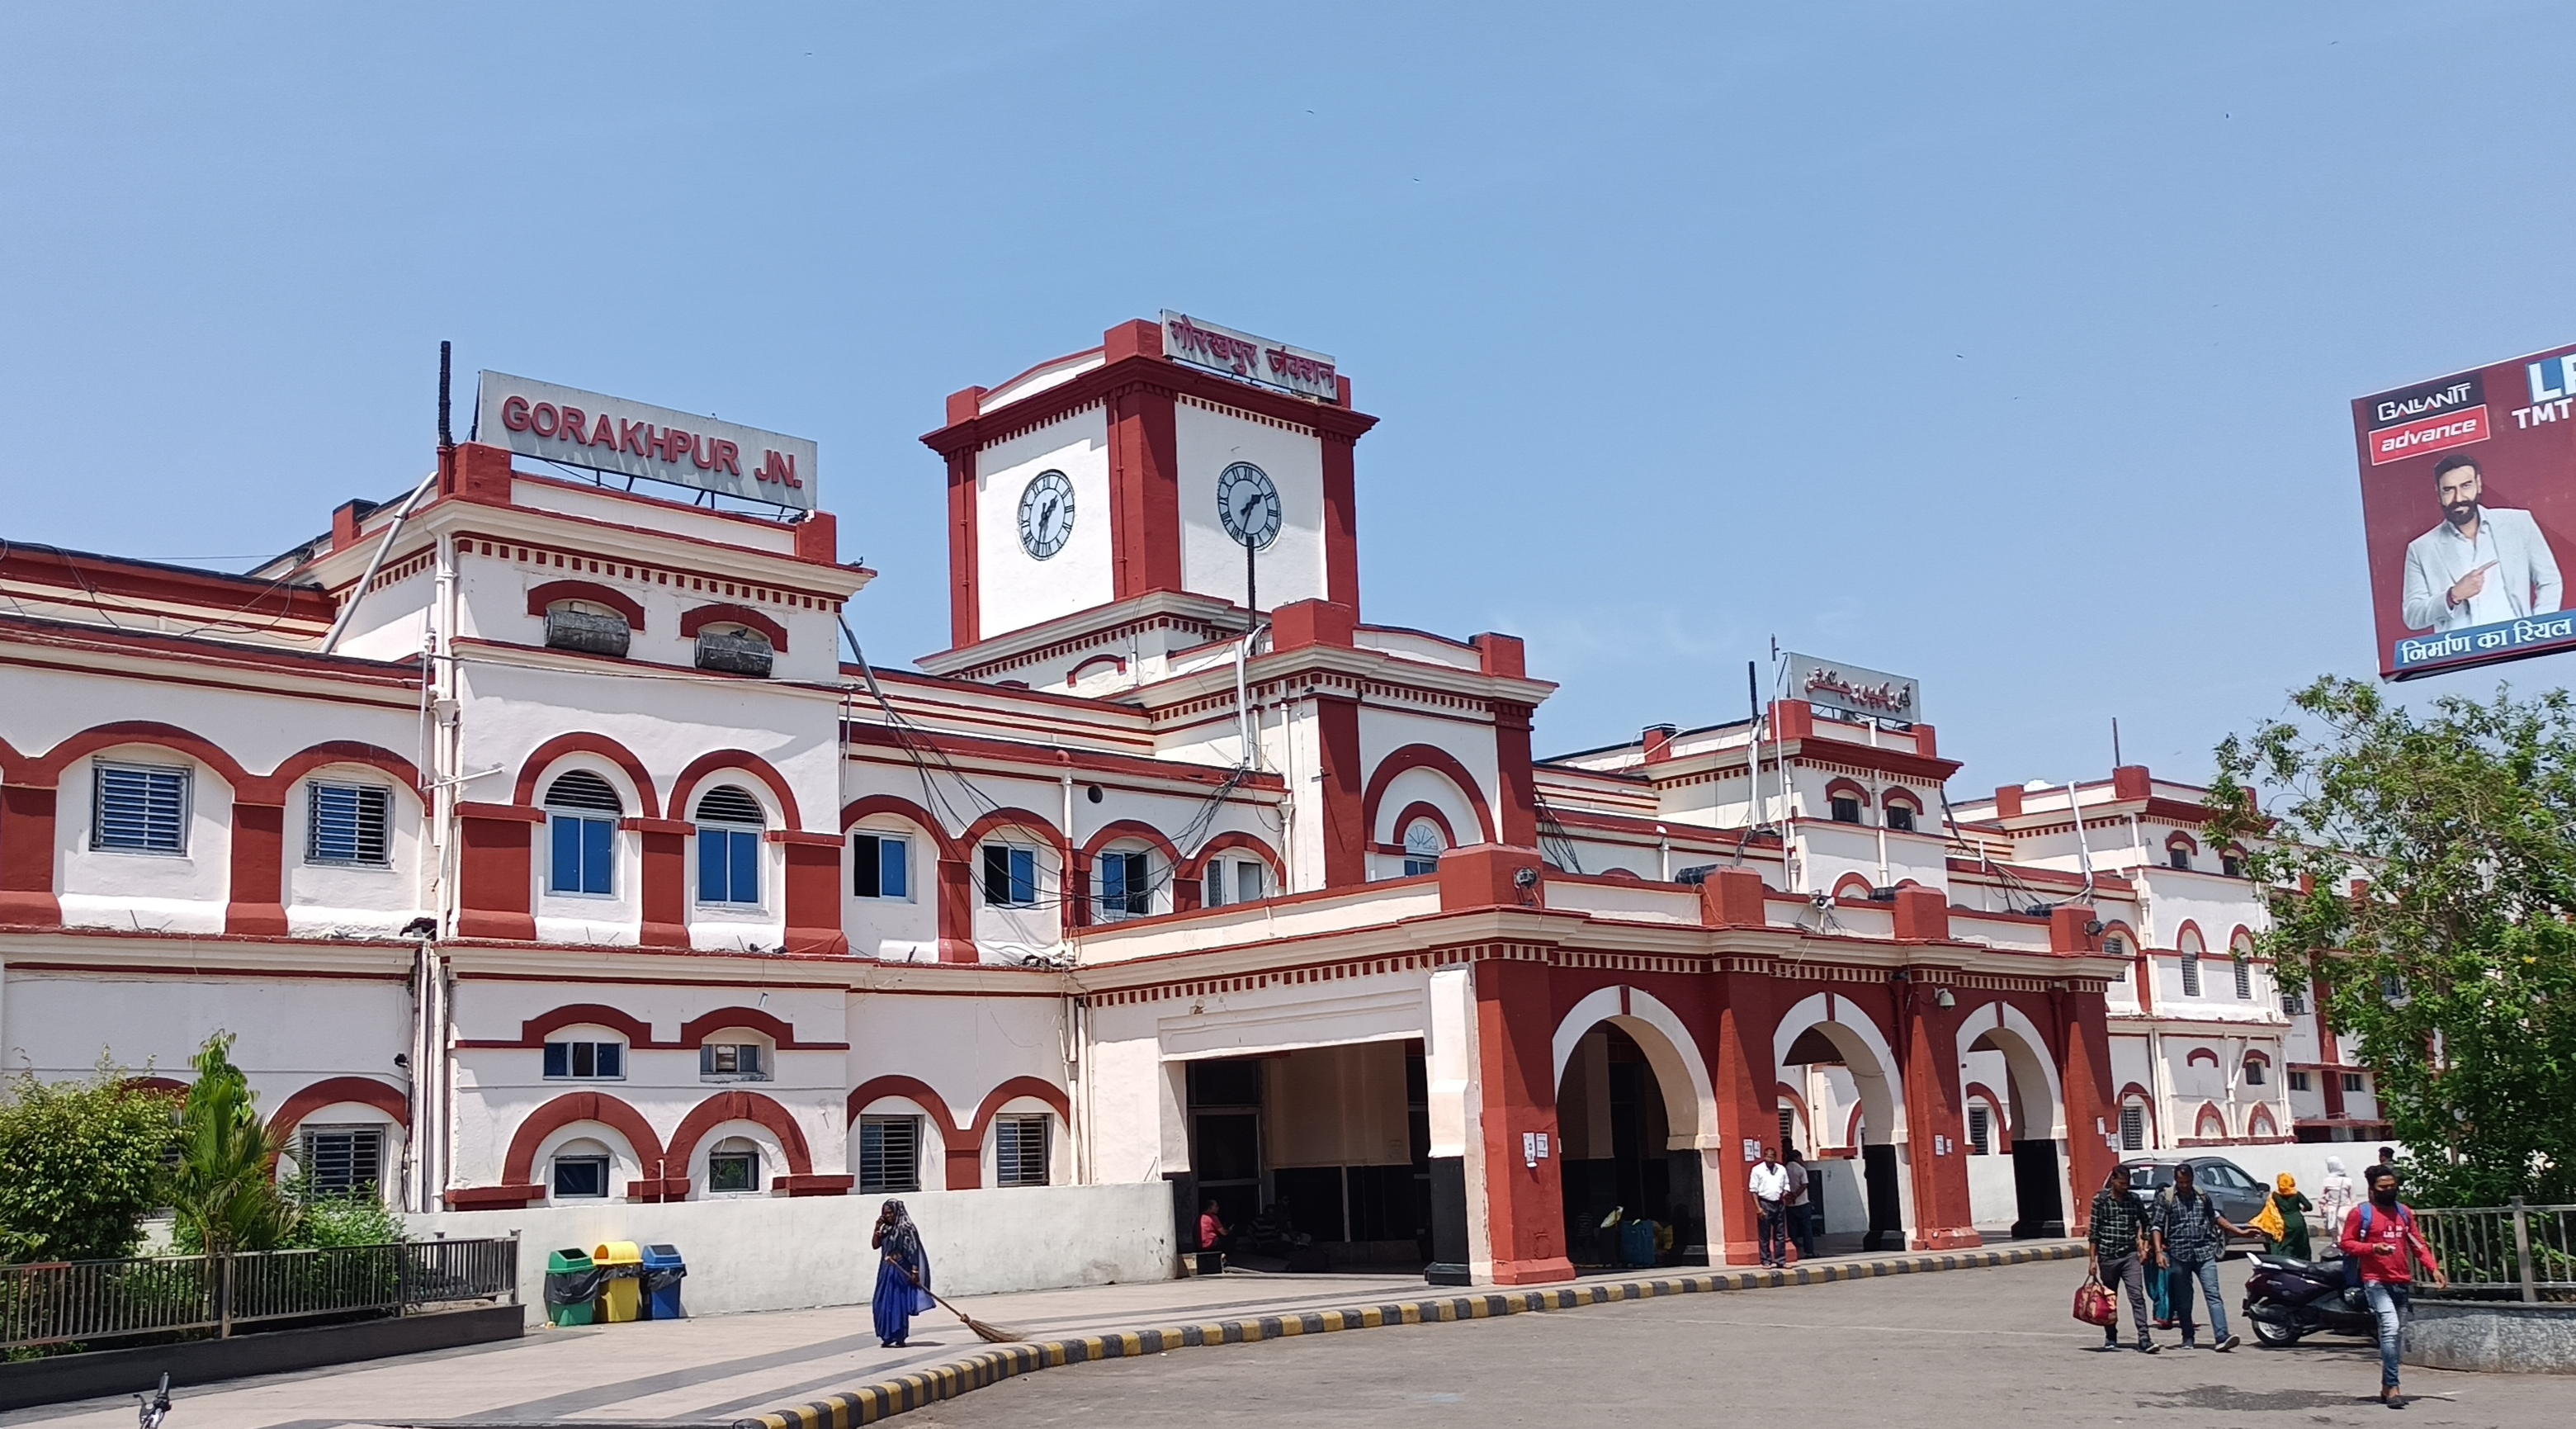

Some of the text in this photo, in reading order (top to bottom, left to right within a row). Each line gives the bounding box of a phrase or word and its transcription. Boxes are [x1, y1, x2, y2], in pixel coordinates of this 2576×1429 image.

[1169, 314, 1335, 388] गोरखपुर जंक्शन
[2380, 418, 2477, 452] advance
[2512, 398, 2574, 429] TMT
[502, 395, 802, 489] GORAKHPUR JN.
[2400, 617, 2573, 664] निर्माण का रियल
